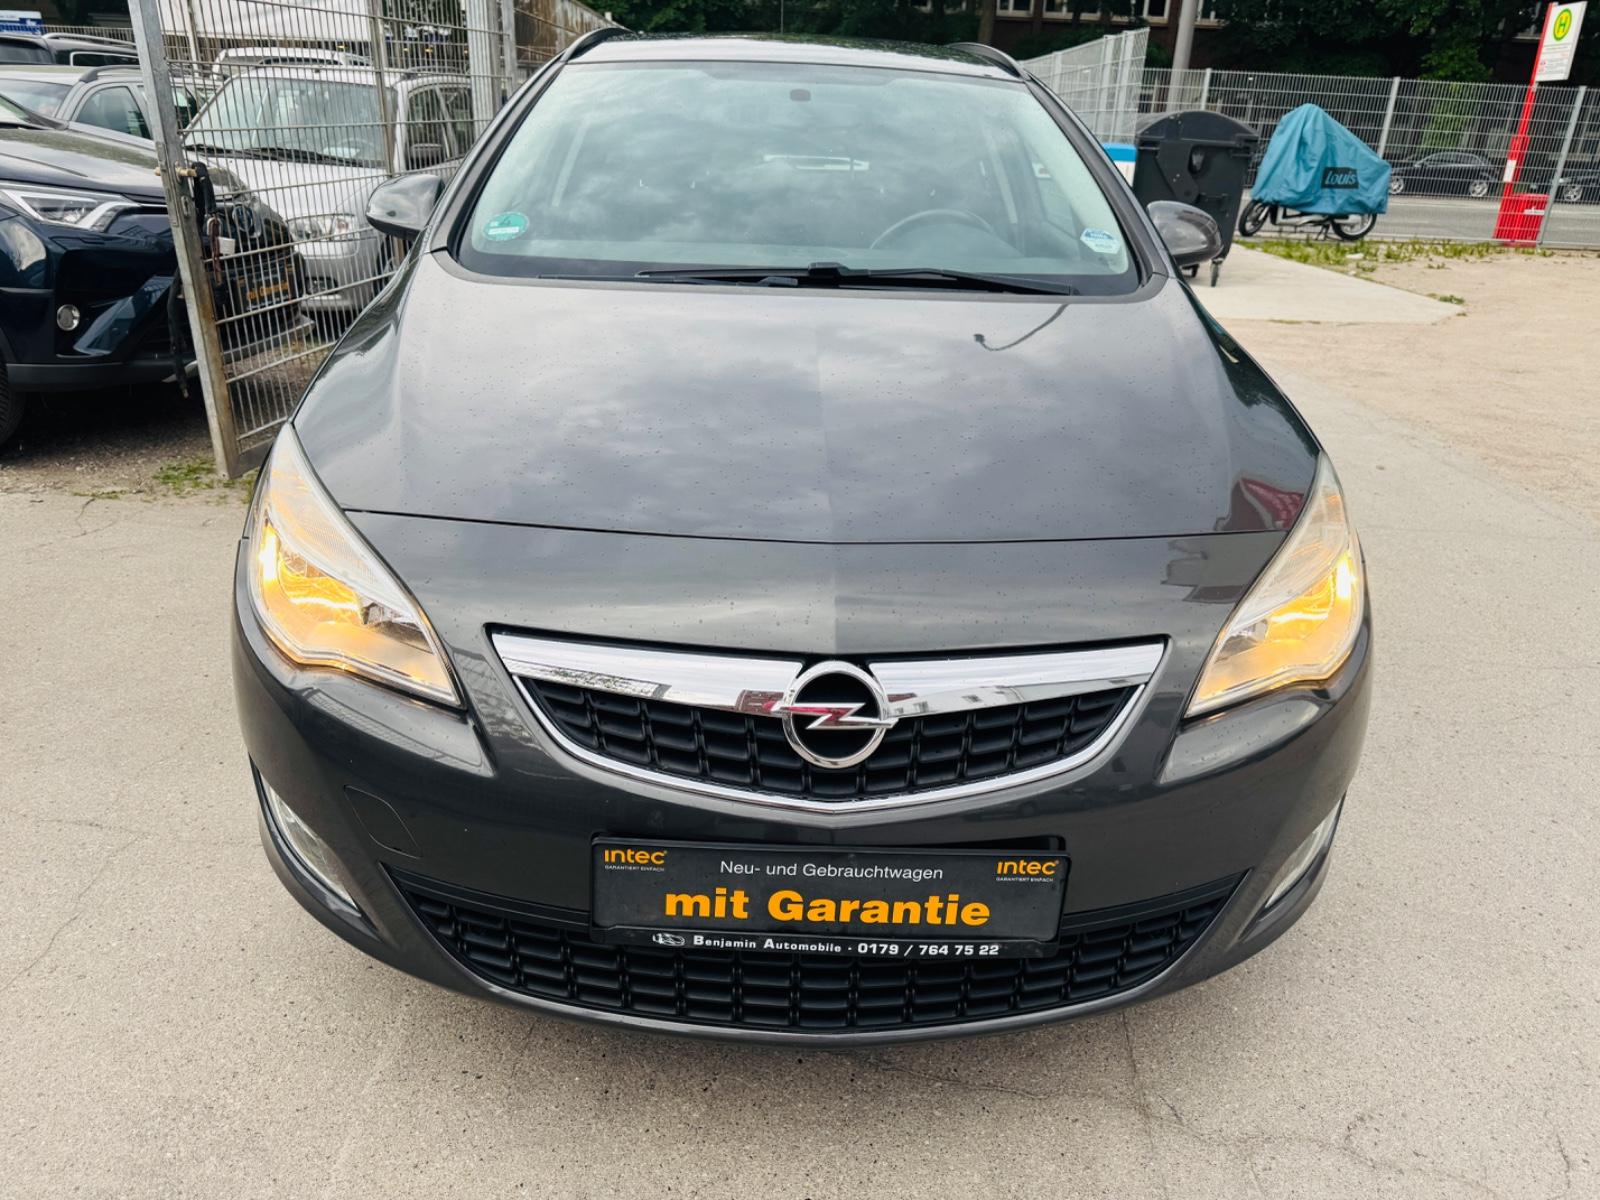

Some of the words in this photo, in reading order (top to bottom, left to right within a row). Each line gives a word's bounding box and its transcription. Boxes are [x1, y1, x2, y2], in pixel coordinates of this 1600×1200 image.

[1325, 170, 1356, 185] Louis
[719, 860, 761, 875] Neu-
[766, 863, 797, 876] und
[802, 863, 944, 882] Gebrauchtwagen
[665, 887, 749, 919] mit
[767, 889, 991, 927] Garantie
[693, 935, 757, 949] Benjamin
[763, 938, 842, 953] Automobile
[857, 942, 899, 955] 0179
[918, 944, 949, 956] 764
[954, 944, 974, 956] 75
[978, 944, 1000, 956] 22
